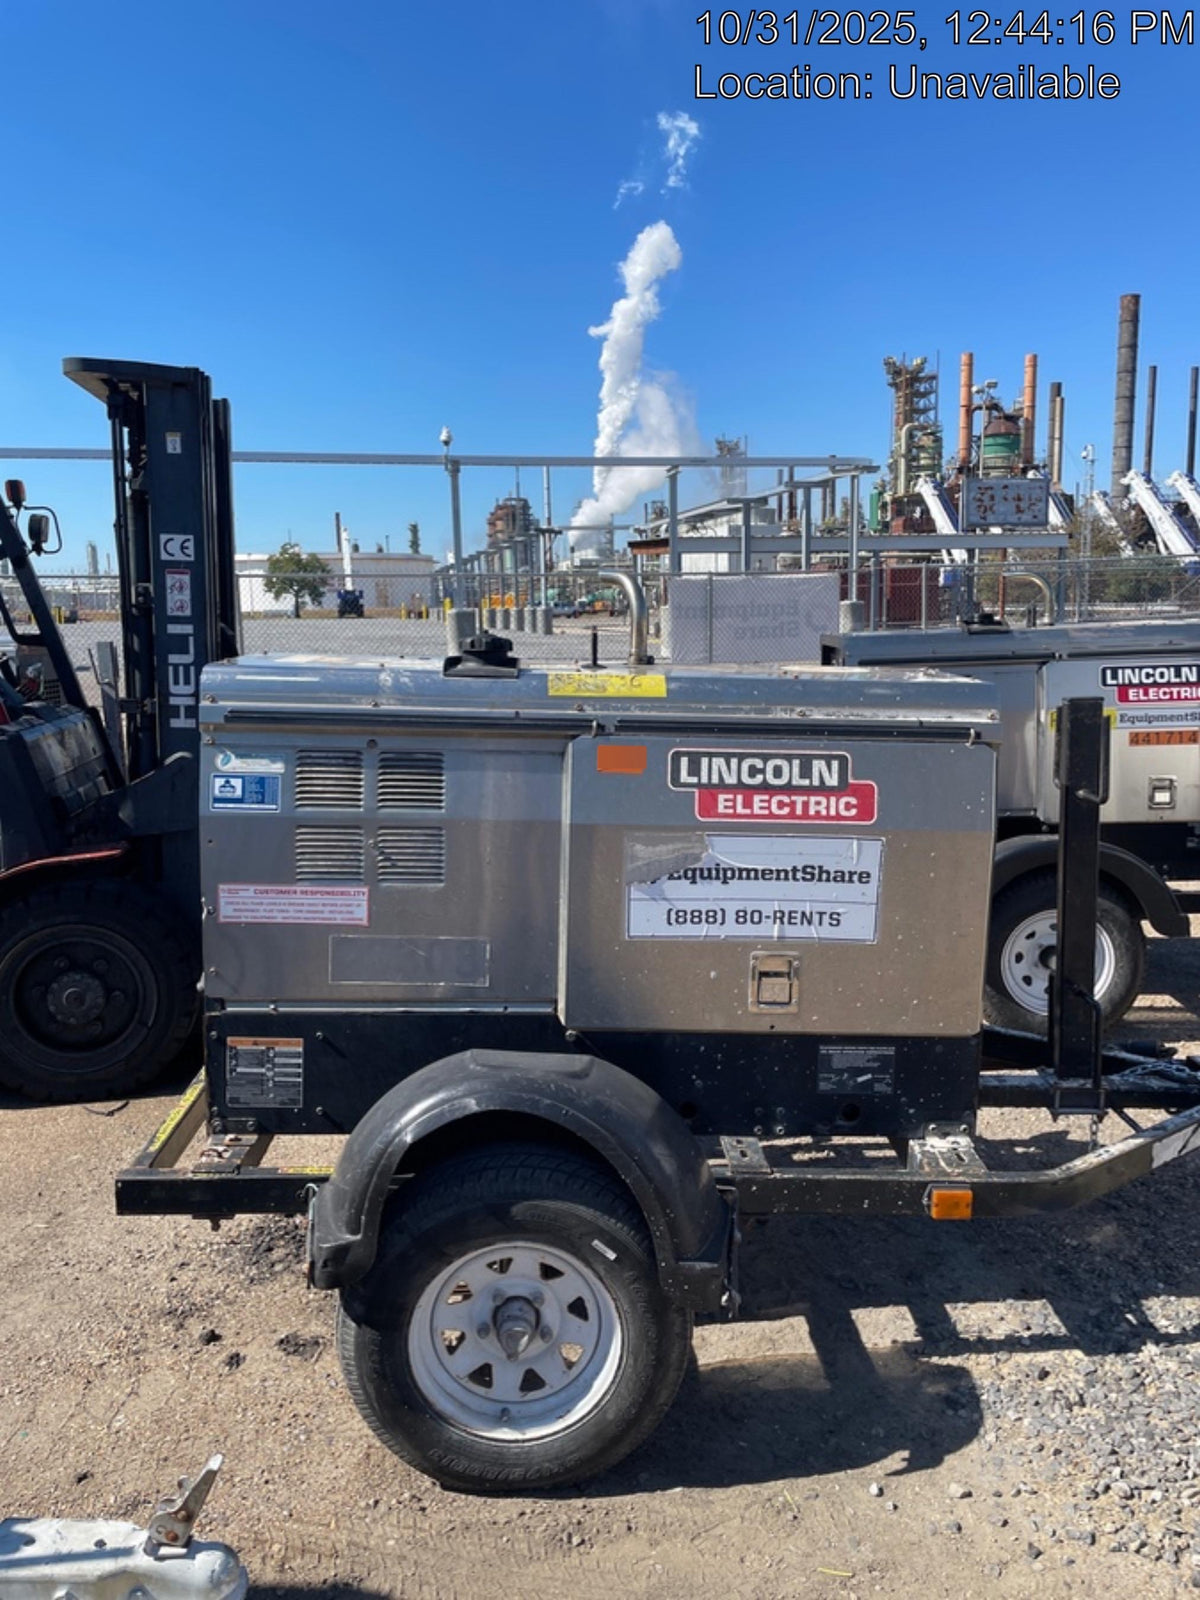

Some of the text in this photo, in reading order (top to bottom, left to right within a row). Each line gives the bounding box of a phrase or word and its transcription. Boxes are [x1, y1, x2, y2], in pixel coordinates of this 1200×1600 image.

[163, 537, 191, 557] CE
[167, 623, 196, 728] HELI
[1106, 667, 1197, 685] LINCOLN
[1128, 687, 1200, 700] ELECTRI
[1130, 731, 1198, 746] 441714
[680, 756, 838, 787] LINCOLN
[717, 794, 858, 816] ELECTRIC
[666, 908, 841, 927] (888) 80-RENTS
